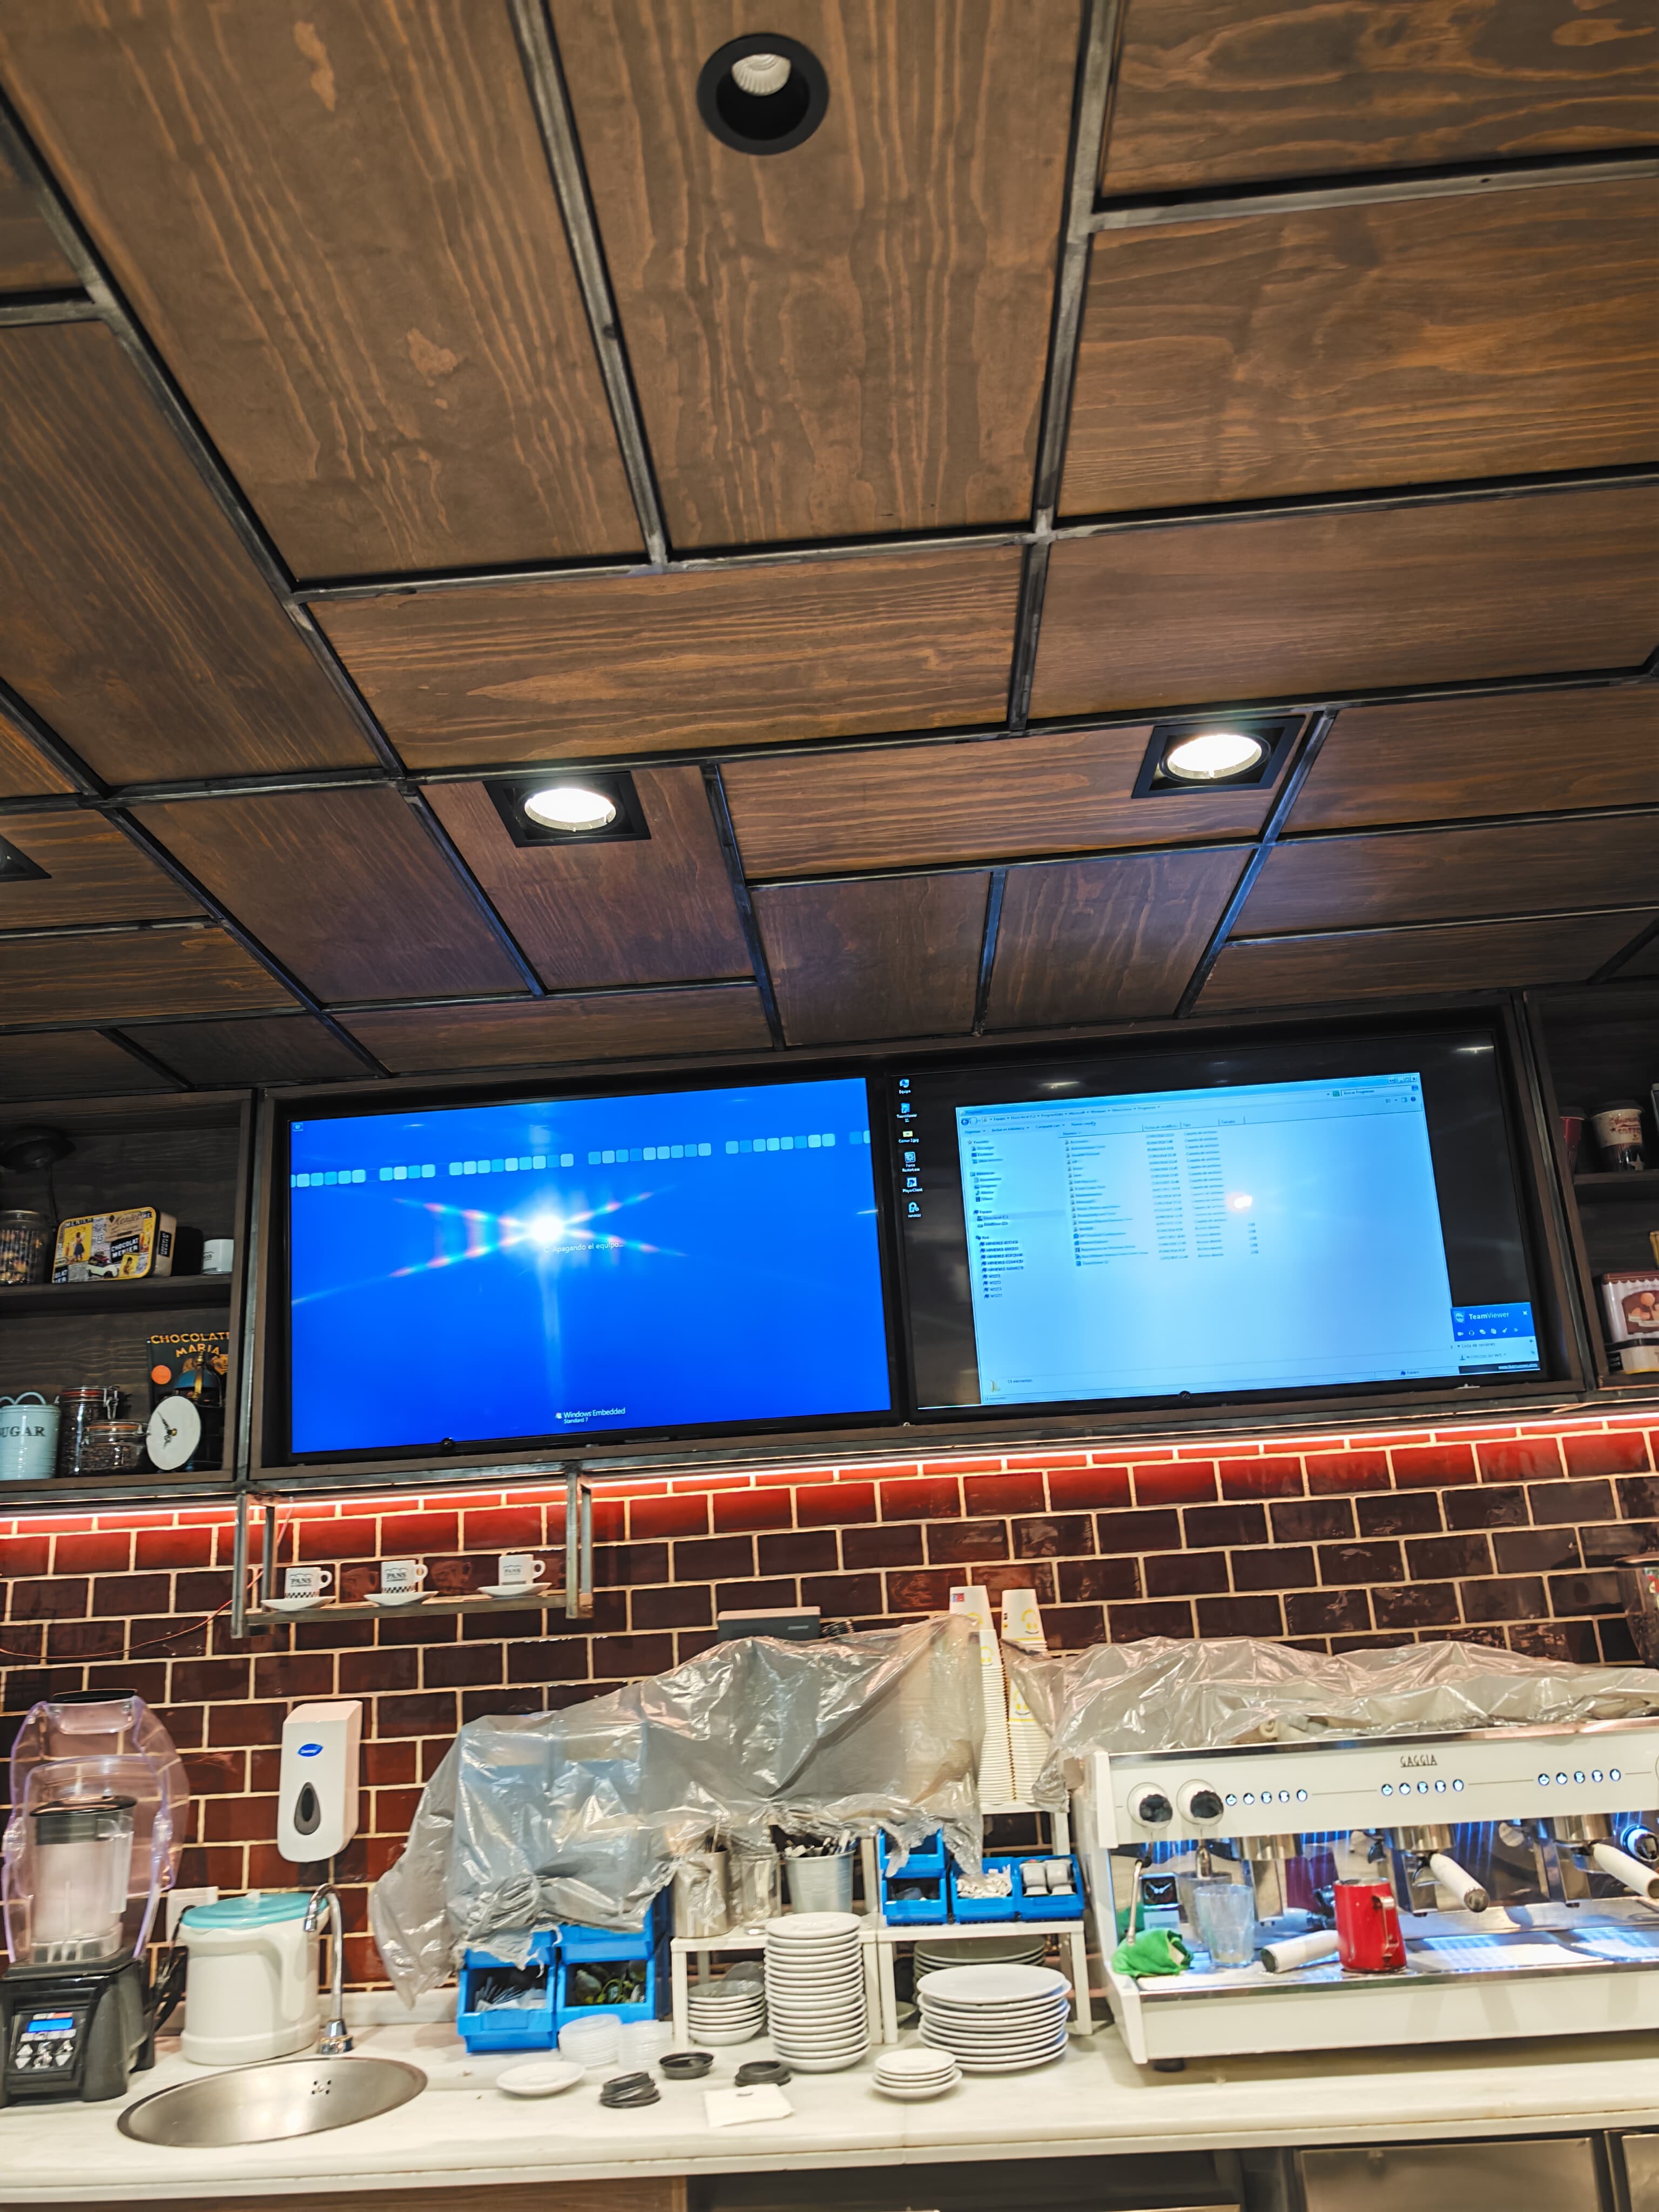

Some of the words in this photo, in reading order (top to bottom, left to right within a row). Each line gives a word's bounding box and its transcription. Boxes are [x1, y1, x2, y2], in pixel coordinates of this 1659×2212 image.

[553, 1244, 586, 1253] Apagando
[176, 1343, 219, 1358] MARIA
[592, 1407, 625, 1417] Embedded
[0, 1426, 46, 1437] UGAR
[1400, 1754, 1438, 1768] GAGGIA
